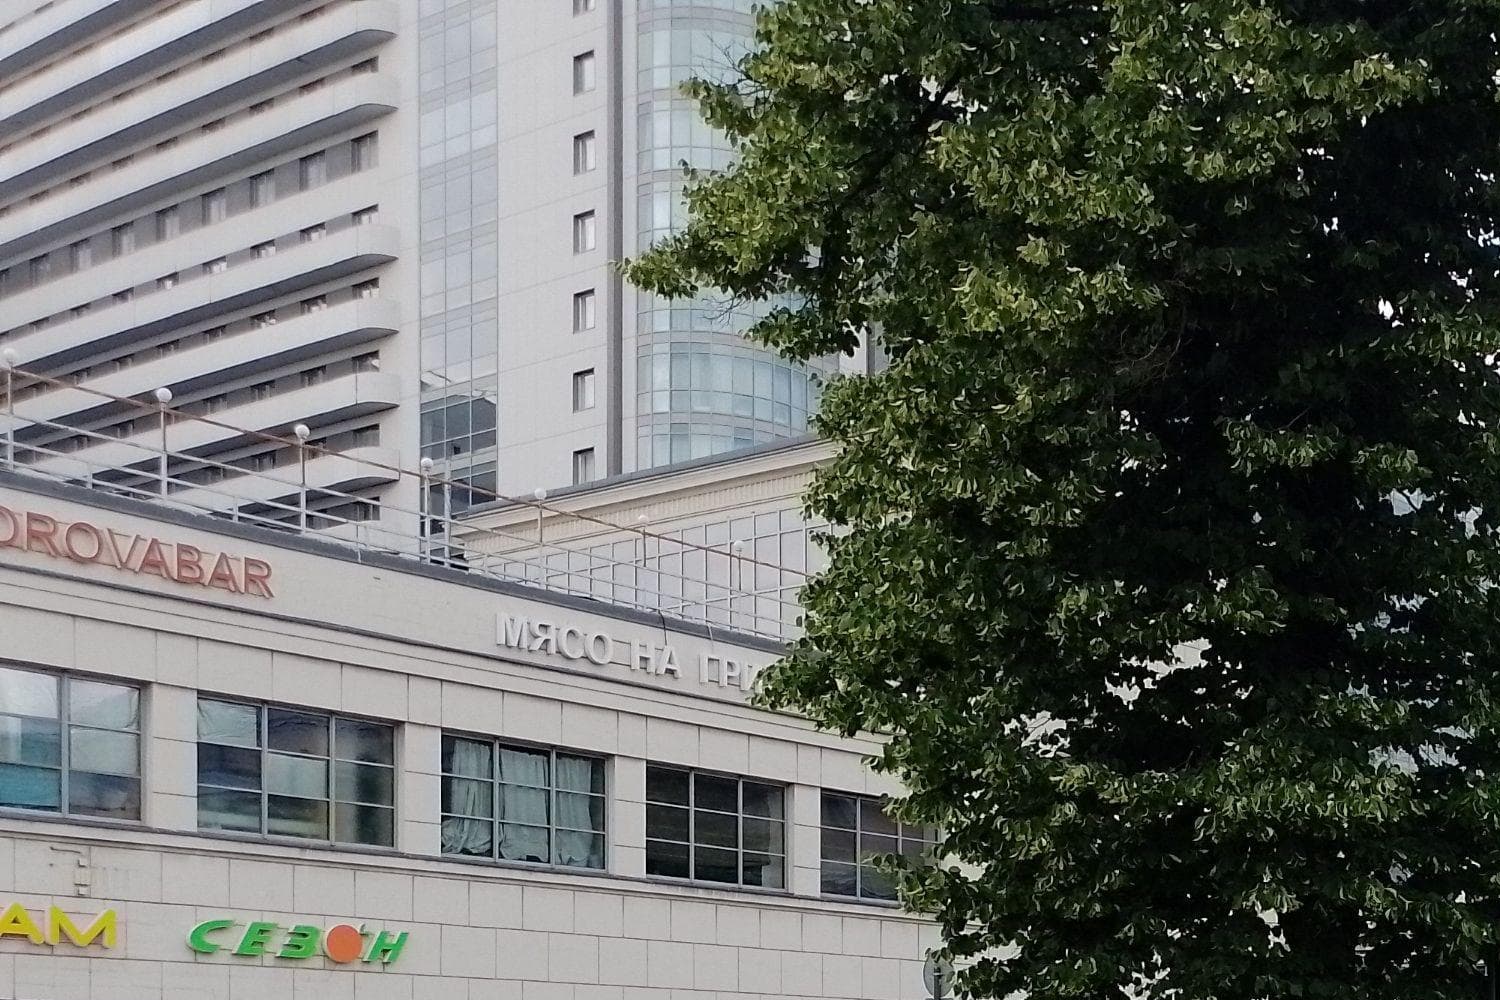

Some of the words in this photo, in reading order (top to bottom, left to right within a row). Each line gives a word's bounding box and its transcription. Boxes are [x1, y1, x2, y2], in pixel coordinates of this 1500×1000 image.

[496, 612, 613, 665] МЯСО
[631, 639, 682, 679] НА
[699, 655, 762, 694] ГРИ
[187, 919, 409, 964] СЕЗОН
